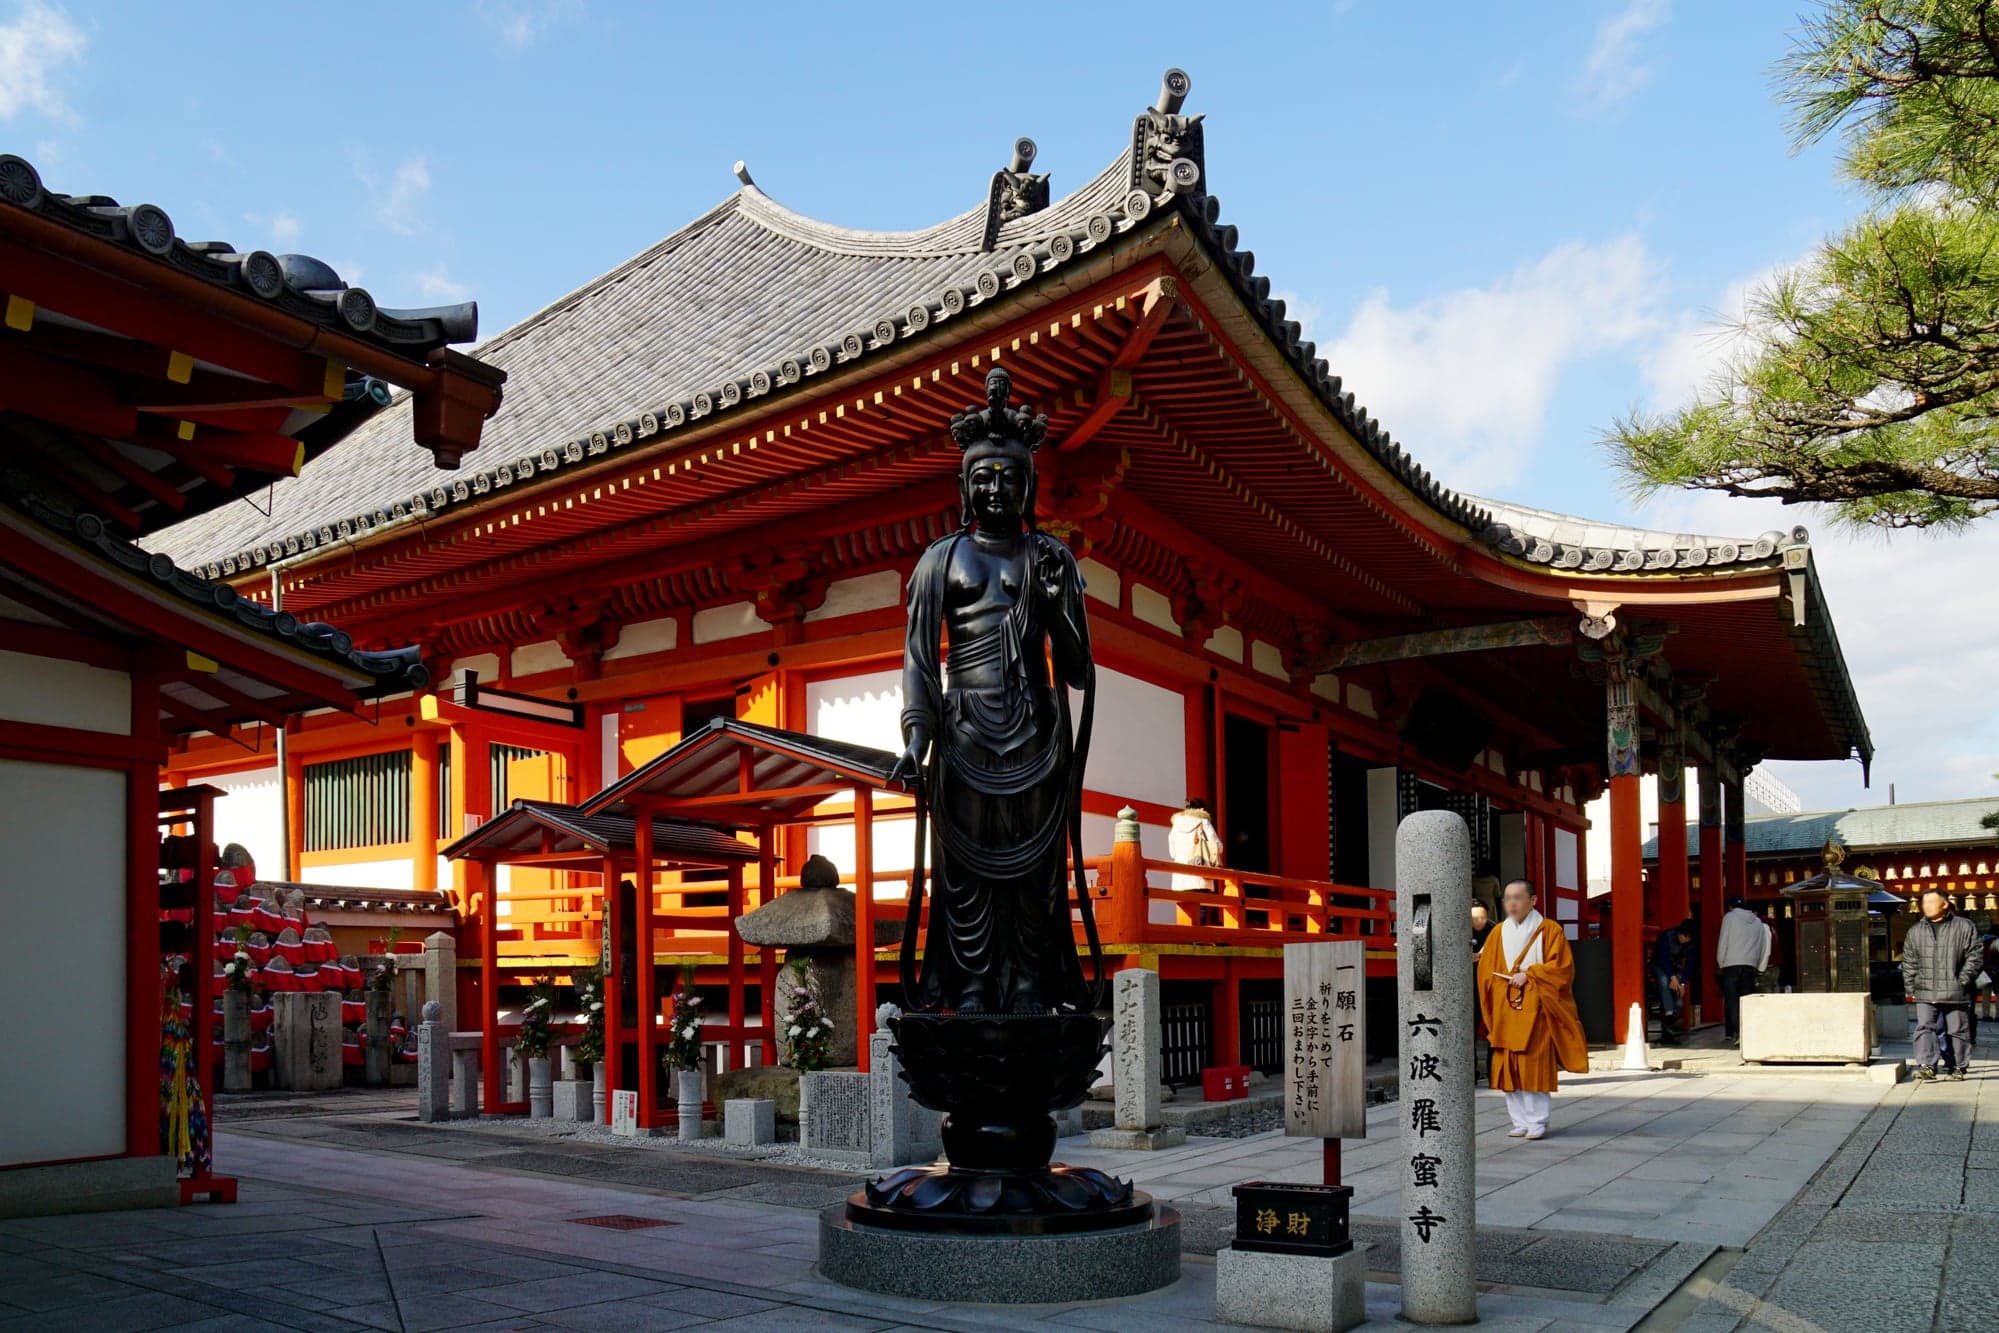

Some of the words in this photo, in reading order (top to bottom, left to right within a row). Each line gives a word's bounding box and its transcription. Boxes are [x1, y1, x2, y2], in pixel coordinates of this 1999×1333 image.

[1319, 981, 1332, 1068] 祈りをこめて
[1336, 964, 1356, 1042] 一願石
[1306, 997, 1318, 1112] 金文字から手前に
[1408, 1013, 1446, 1244] 六波羅蜜寺
